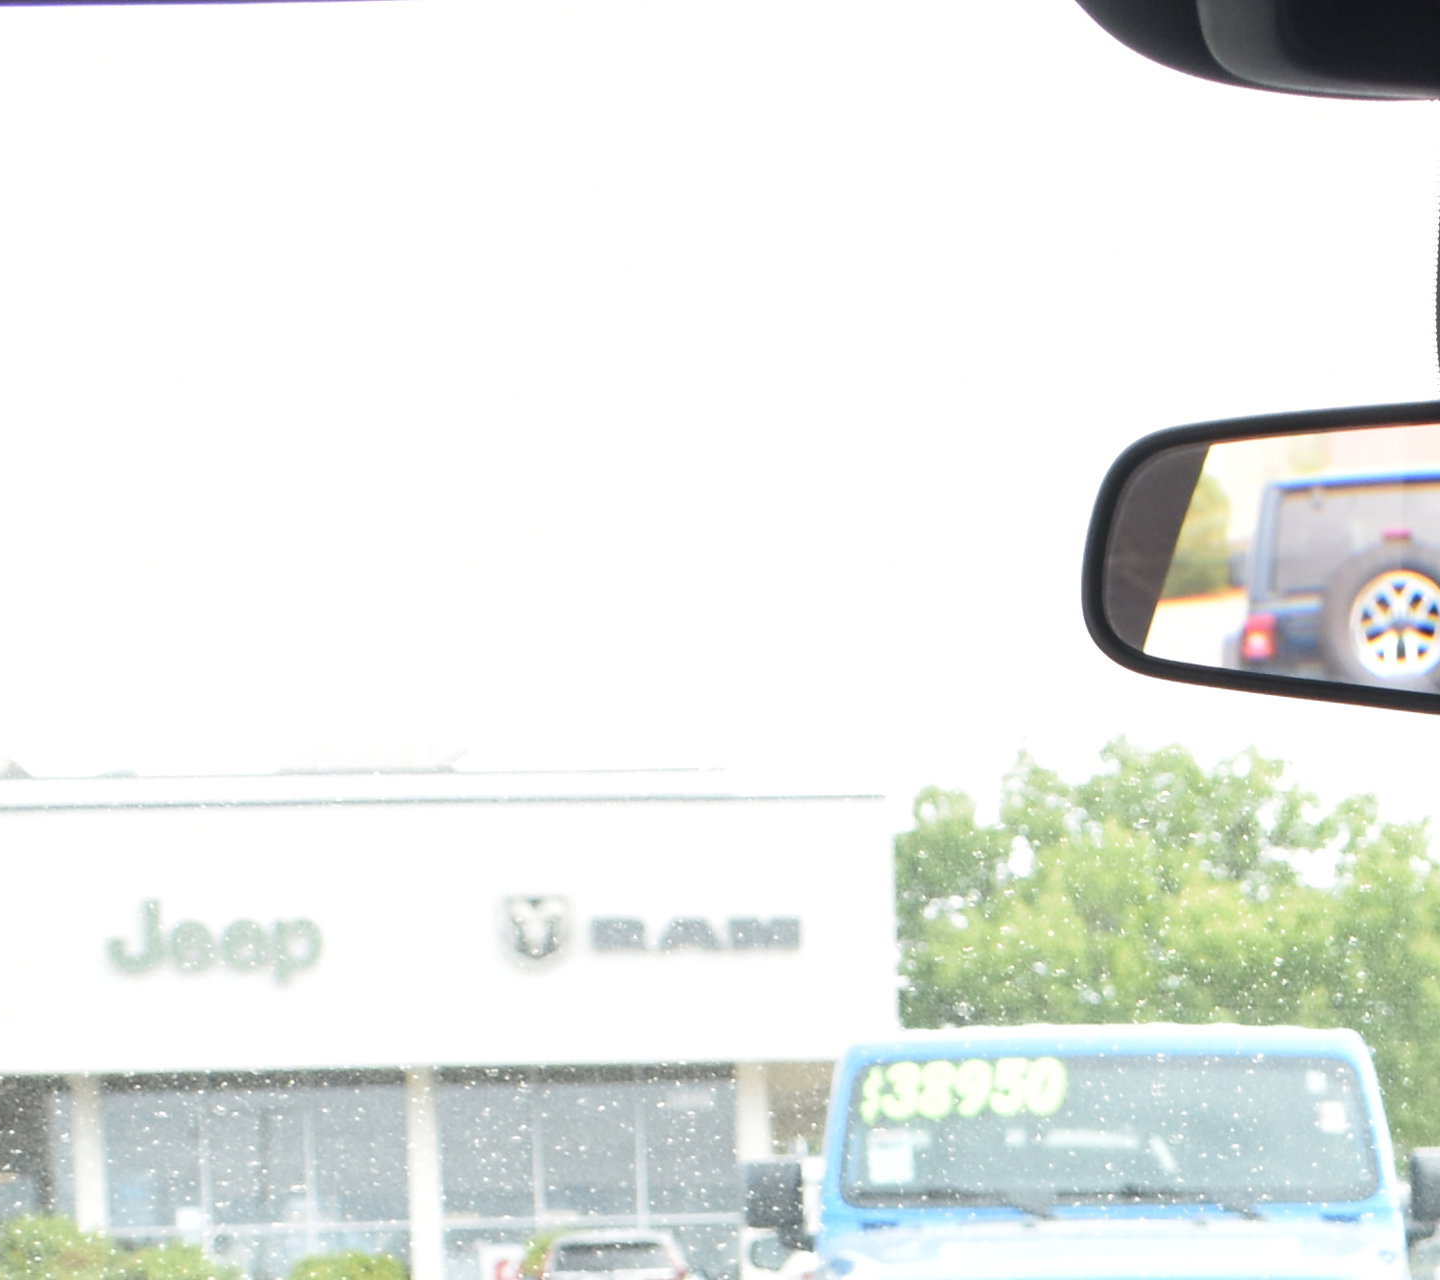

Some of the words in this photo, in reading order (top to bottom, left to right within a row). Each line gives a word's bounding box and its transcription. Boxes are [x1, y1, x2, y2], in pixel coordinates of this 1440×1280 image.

[106, 898, 324, 987] Jeep
[591, 916, 801, 952] RAM
[860, 1056, 1068, 1124] $38950
